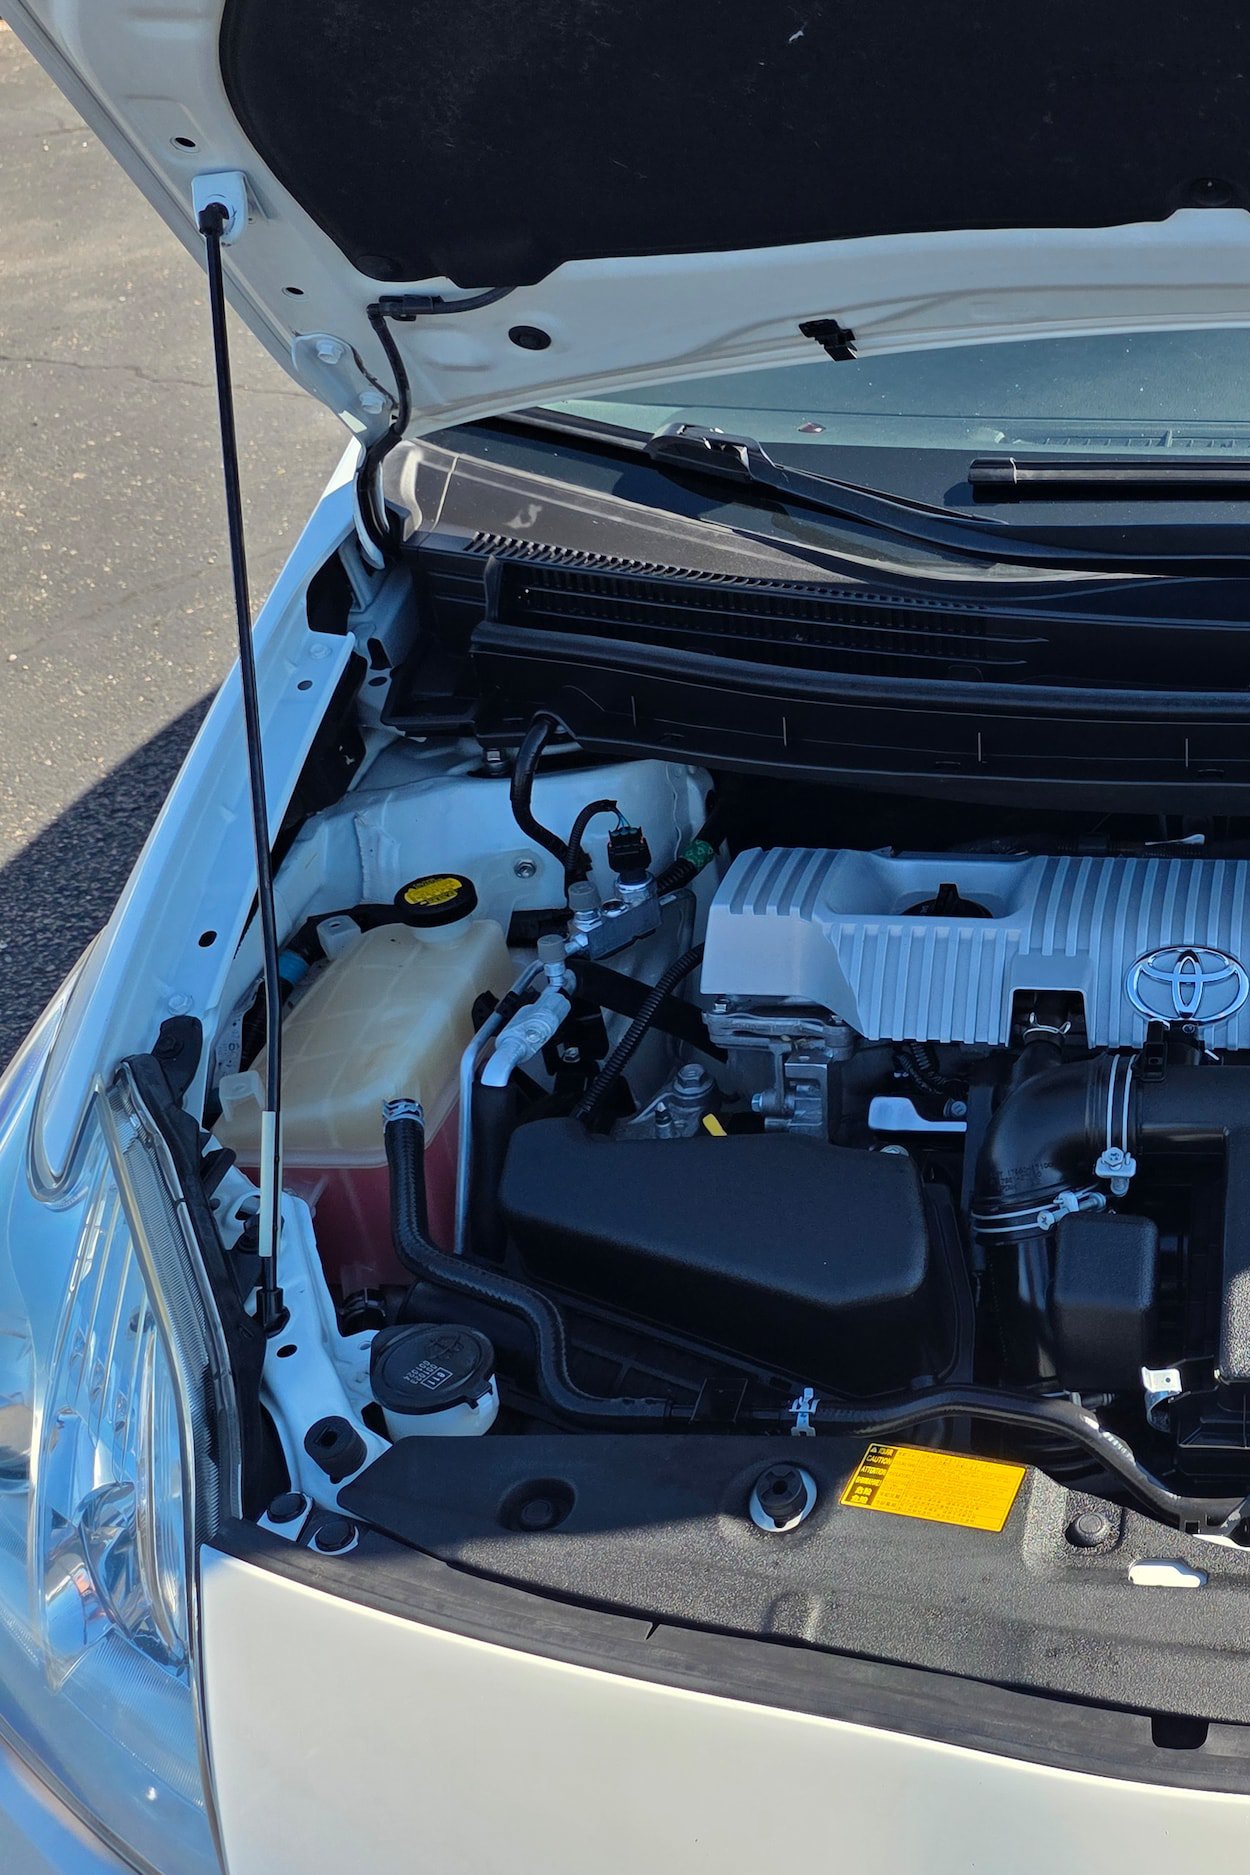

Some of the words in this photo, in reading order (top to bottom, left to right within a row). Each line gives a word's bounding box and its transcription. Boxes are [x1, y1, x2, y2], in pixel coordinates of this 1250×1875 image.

[403, 1360, 431, 1382] 001024
[427, 1371, 446, 1386] e11
[866, 1454, 892, 1465] CAUTION
